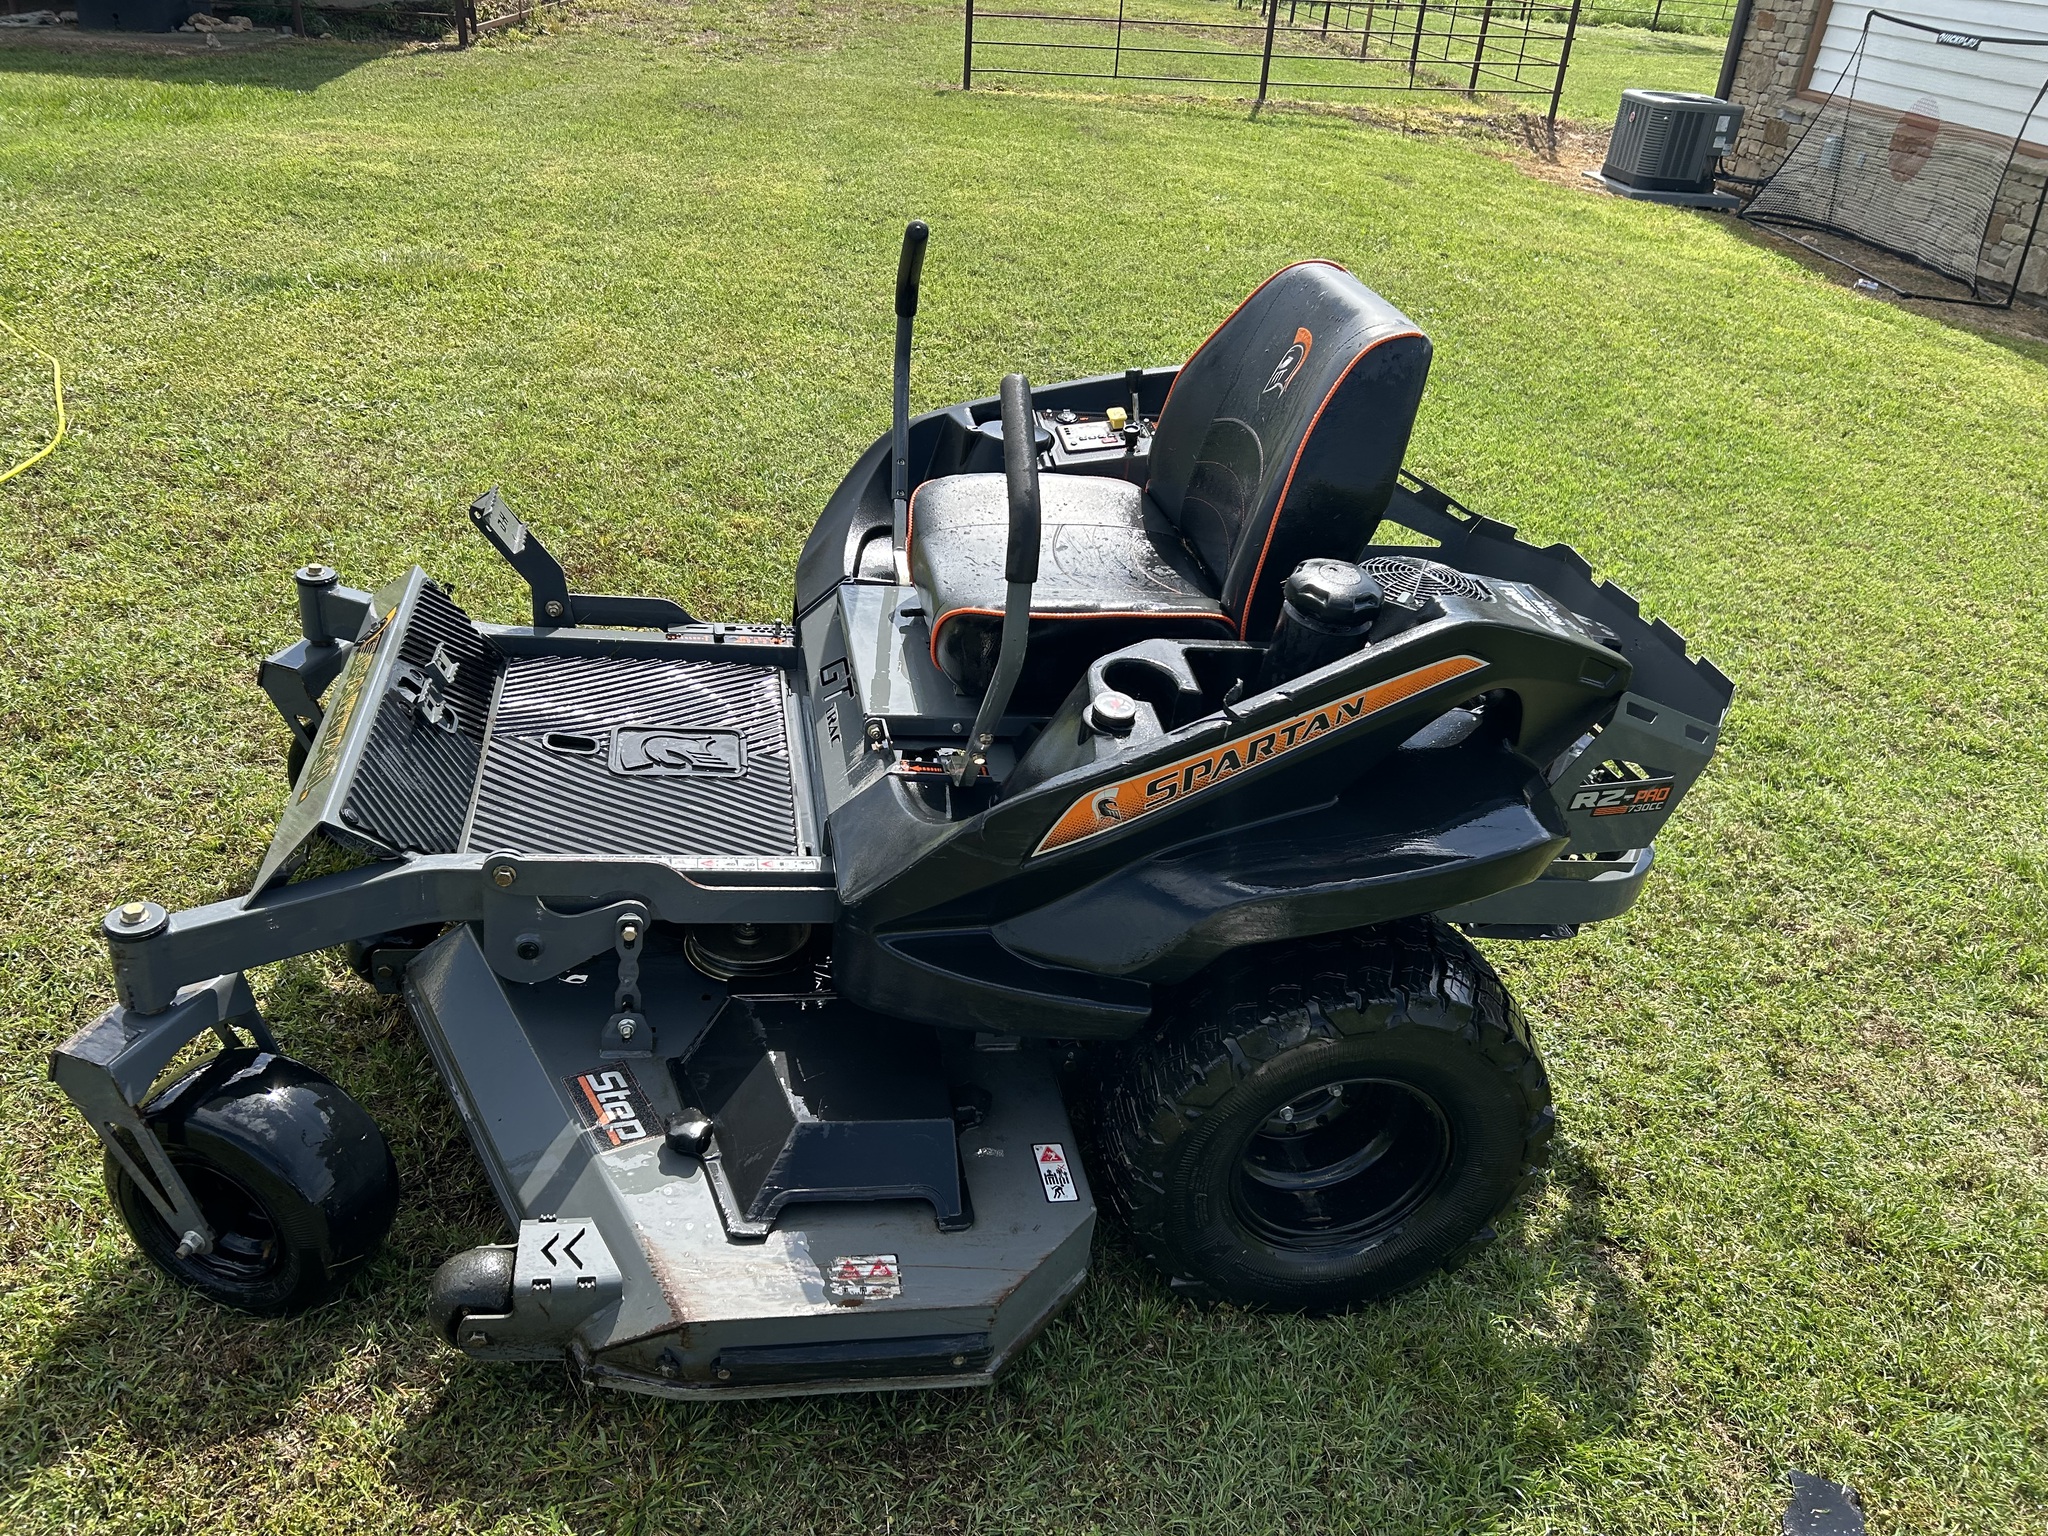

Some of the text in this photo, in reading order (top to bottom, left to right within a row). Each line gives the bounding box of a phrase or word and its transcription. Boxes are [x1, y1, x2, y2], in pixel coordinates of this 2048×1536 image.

[819, 656, 855, 702] GT
[1144, 695, 1366, 810] SPARTAN
[1569, 787, 1672, 810] RZ-PRO
[1627, 801, 1664, 813] 730CC
[585, 1070, 647, 1140] Step
